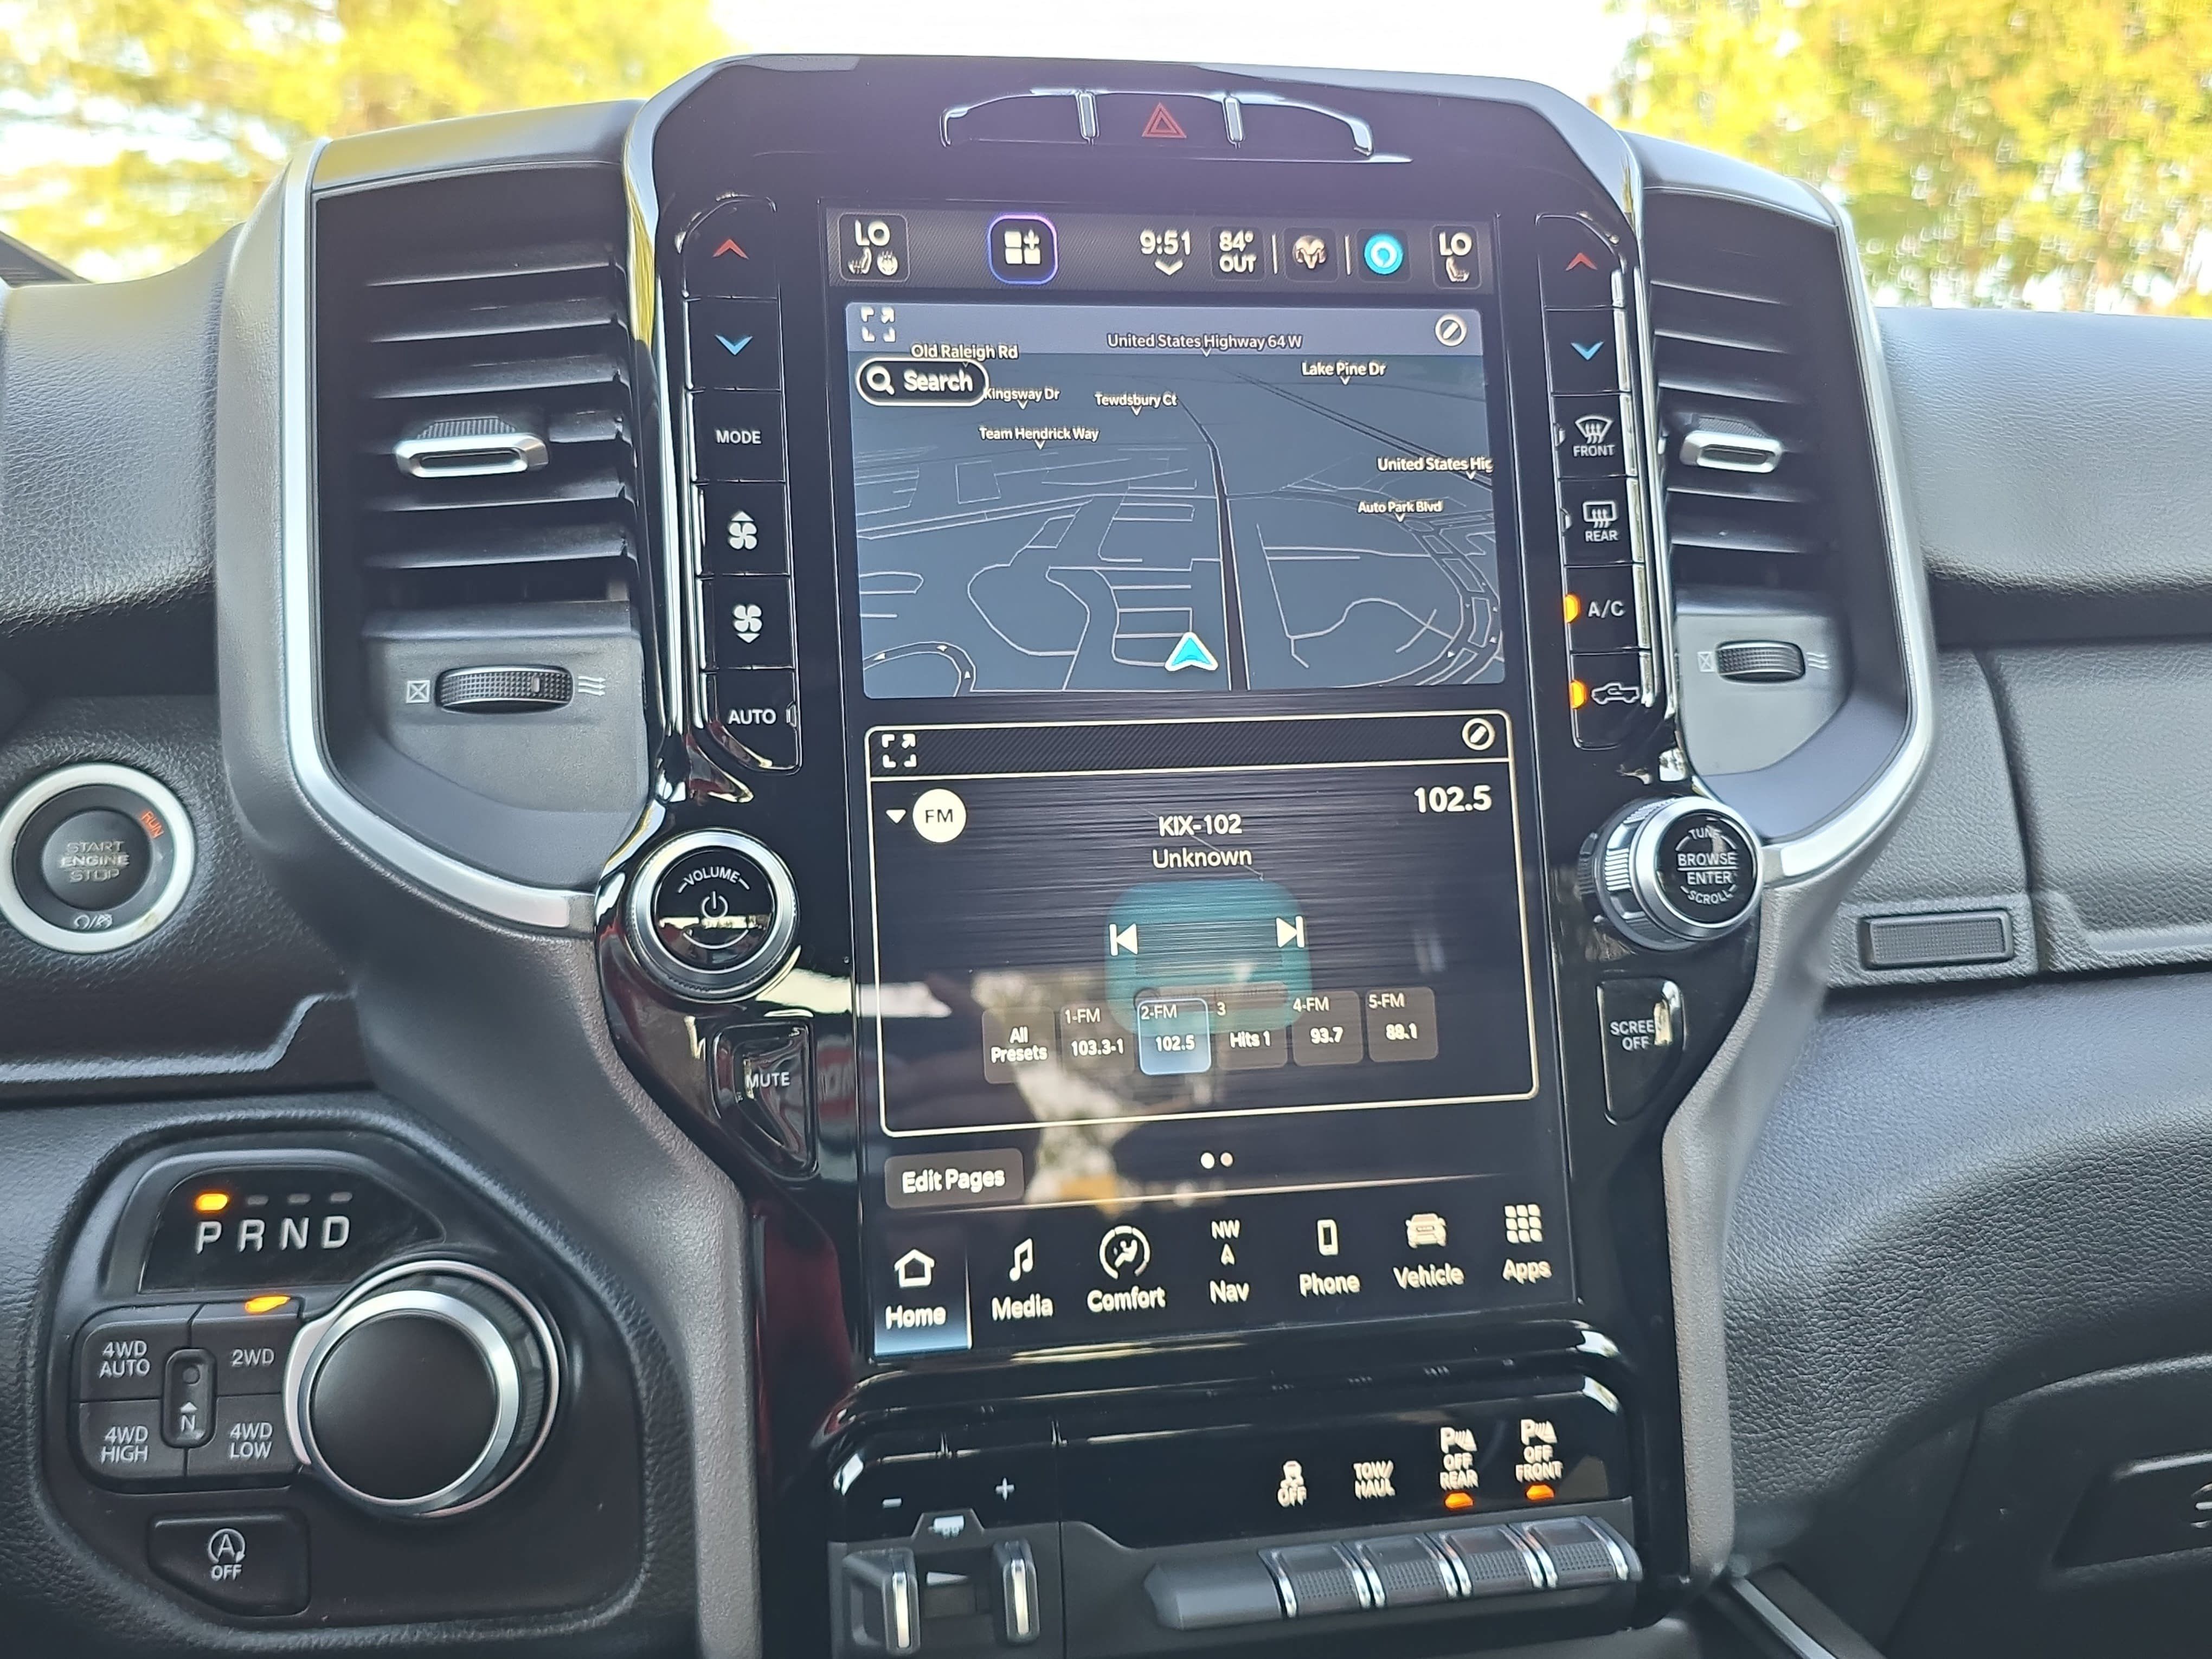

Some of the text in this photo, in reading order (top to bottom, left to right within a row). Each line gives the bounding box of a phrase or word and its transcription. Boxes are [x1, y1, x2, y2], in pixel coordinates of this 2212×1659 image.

[854, 220, 890, 246] LO
[1219, 231, 1253, 252] 84°
[1139, 230, 1191, 255] 9:51
[1439, 232, 1472, 256] LO
[1219, 254, 1256, 273] OUT
[1107, 334, 1302, 351] United States Highway 64 W
[911, 344, 1019, 360] Old Raleigh Rd
[1302, 361, 1386, 376] Lake Pine Dr
[903, 369, 973, 392] Search
[983, 387, 1059, 402] Kingsway Dr
[1095, 393, 1178, 408] Tewdsbury Ct
[716, 429, 762, 445] MODE
[979, 427, 1099, 443] Team Hendrick Way
[1573, 445, 1613, 456] FRONT
[1377, 456, 1424, 471] United
[1425, 457, 1468, 471] States
[1358, 501, 1442, 513] Auto Park Blvd
[1585, 530, 1618, 542] REAR
[1588, 600, 1625, 618] A/C
[728, 709, 776, 725] AUTO
[1414, 785, 1492, 813] 102.5
[142, 811, 164, 839] RUN
[925, 809, 953, 824] FM
[1159, 814, 1243, 837] KIX-102
[1688, 827, 1722, 840] TUNE
[67, 840, 125, 853] START
[60, 854, 130, 868] ENGINE
[1152, 847, 1252, 869] Unknown
[1677, 852, 1738, 866] BROWSE
[70, 869, 120, 883] STOP
[684, 866, 741, 886] VOLUME
[1687, 872, 1732, 885] ENTER
[1688, 890, 1733, 904] SCROLL
[1217, 1001, 1227, 1016] 3
[1293, 996, 1330, 1013] 4-FM
[1368, 993, 1405, 1009] 5-FM
[1065, 1008, 1101, 1024] 1-FM
[1141, 1004, 1178, 1020] 2-FM
[1009, 1027, 1028, 1044] All
[1310, 1026, 1343, 1044] 93.7
[1610, 1019, 1664, 1036] SCREE
[1071, 1038, 1124, 1057] 103.3-1
[1155, 1034, 1195, 1052] 102.5
[1229, 1030, 1271, 1049] Hits 1
[1622, 1036, 1650, 1051] OFF
[991, 1045, 1048, 1063] Presets
[745, 1072, 790, 1087] MUTE
[902, 1168, 1005, 1194] Edit Pages
[196, 1216, 350, 1253] P R N D
[1211, 1220, 1240, 1239] NW
[1393, 1262, 1464, 1290] Vehicle
[1502, 1258, 1553, 1284] Apps
[1210, 1280, 1249, 1304] Nav
[1299, 1272, 1360, 1297] Phone
[992, 1293, 1053, 1321] Media
[1086, 1285, 1166, 1312] Comfort
[885, 1305, 946, 1330] Home
[102, 1341, 147, 1356] 4WD
[232, 1349, 274, 1366] 2WD
[99, 1360, 150, 1378] AUTO
[180, 1414, 196, 1431] N
[229, 1423, 272, 1439] 4WD
[104, 1425, 149, 1442] 4WD
[101, 1445, 149, 1463] HIGH
[229, 1442, 272, 1459] LOW
[1523, 1445, 1553, 1463] OFF
[1354, 1461, 1393, 1480] TOW/
[1443, 1453, 1472, 1471] OFF
[1439, 1470, 1478, 1490] REAR
[1516, 1462, 1561, 1482] FRONT
[1277, 1486, 1307, 1506] OFF
[1354, 1481, 1395, 1500] HAUL
[210, 1565, 242, 1580] OFF
